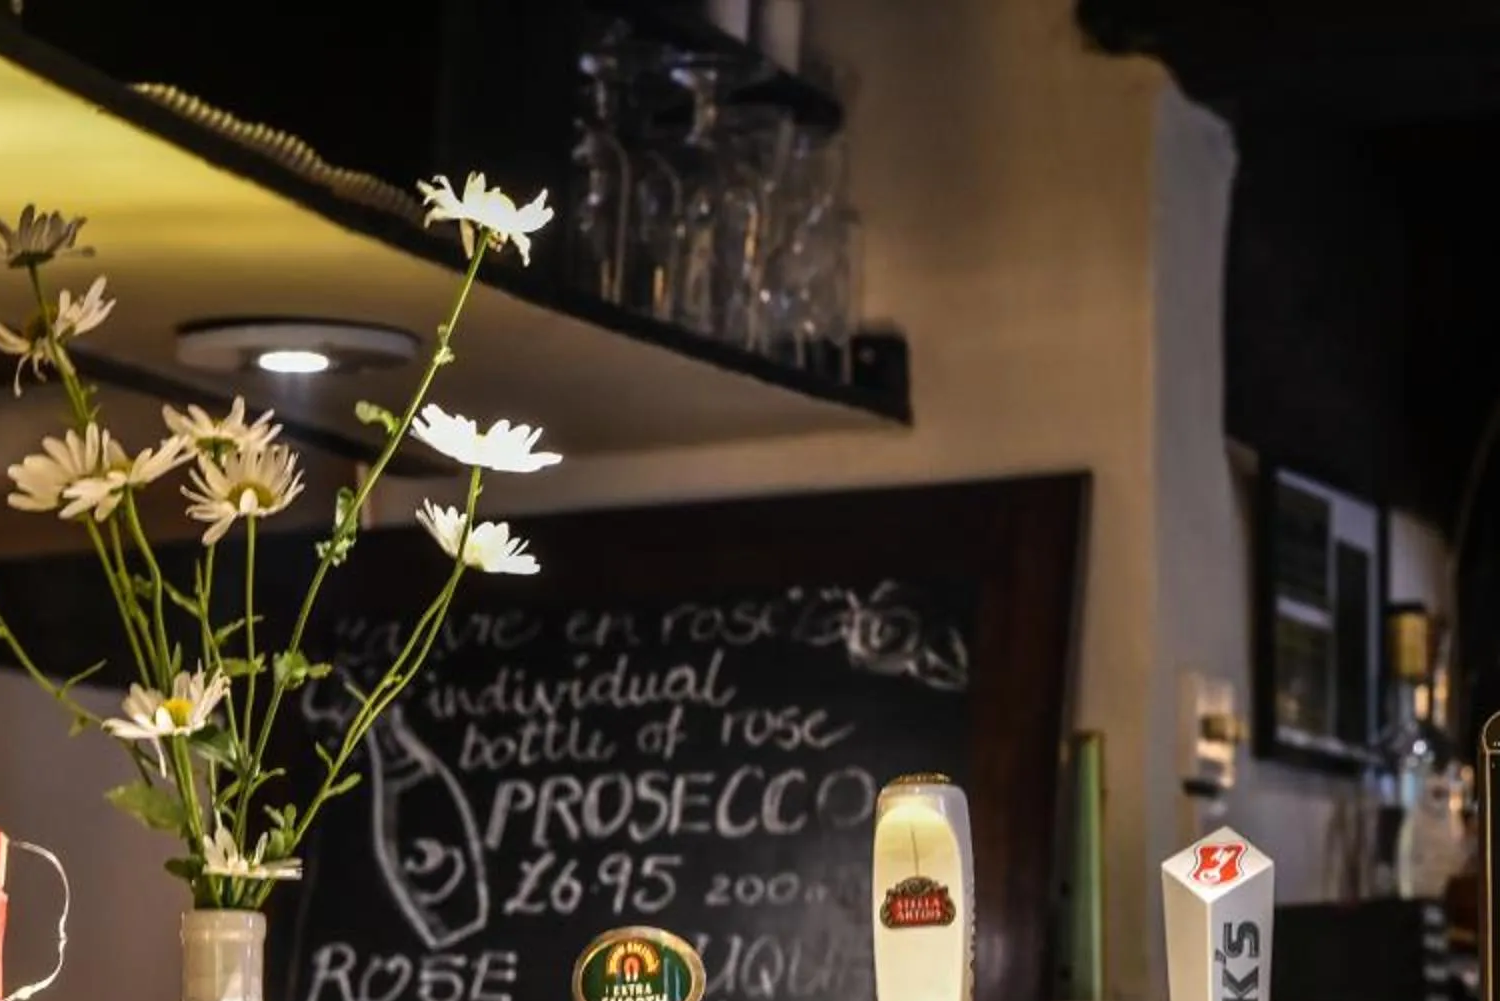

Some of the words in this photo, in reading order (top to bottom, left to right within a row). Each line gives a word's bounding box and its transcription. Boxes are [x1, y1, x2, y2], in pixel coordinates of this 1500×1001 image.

[425, 648, 738, 719] individual
[457, 712, 619, 772] bottle
[636, 704, 687, 761] of
[485, 762, 877, 851] PROSECCO
[612, 982, 654, 997] EXTRA
